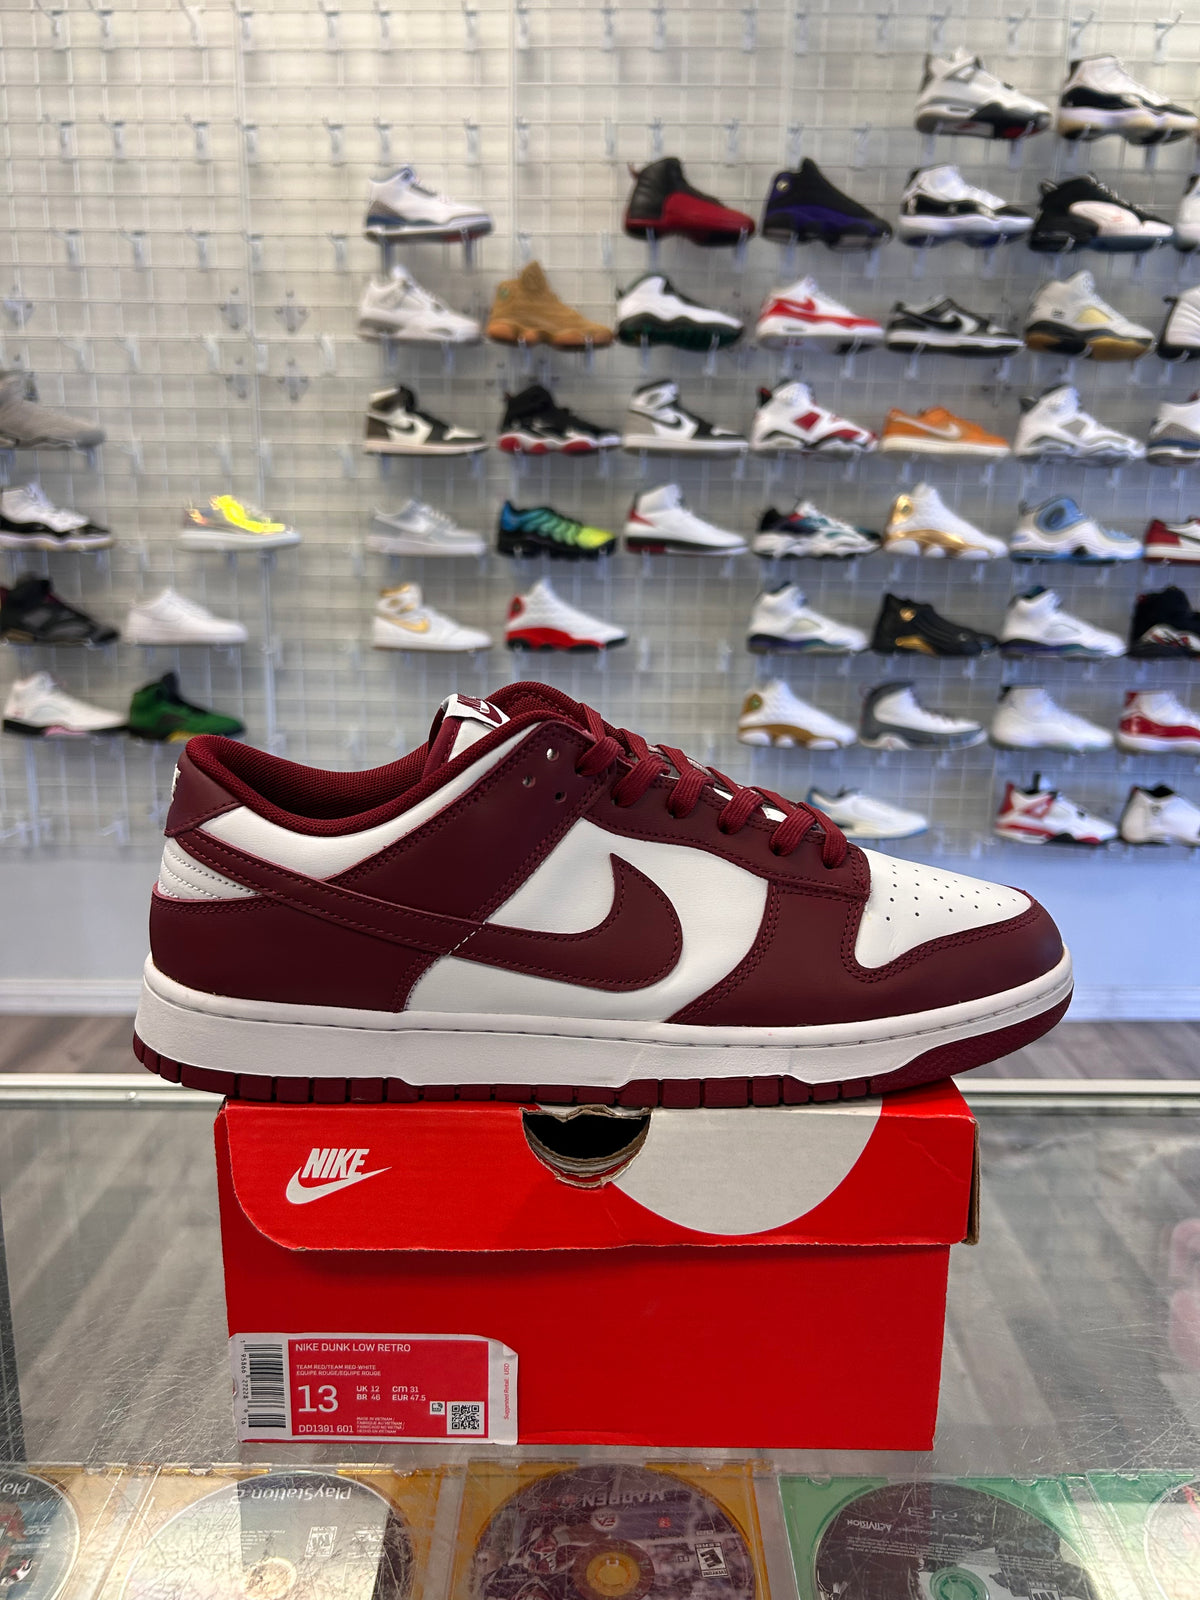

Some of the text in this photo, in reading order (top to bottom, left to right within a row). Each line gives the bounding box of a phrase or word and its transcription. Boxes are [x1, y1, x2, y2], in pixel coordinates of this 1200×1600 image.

[300, 1148, 370, 1180] NIKE
[295, 1343, 411, 1352] NIKE DUNK LOW RETRO
[298, 1384, 339, 1412] 13
[410, 1394, 427, 1402] 47.5
[298, 1424, 335, 1433] DD1391
[336, 1424, 354, 1433] 601
[251, 1483, 352, 1501] PlayStation
[582, 1490, 666, 1508] MADDEN
[596, 1517, 616, 1527] EA
[847, 1519, 893, 1532] ACTIVISION
[700, 1549, 723, 1567] E
